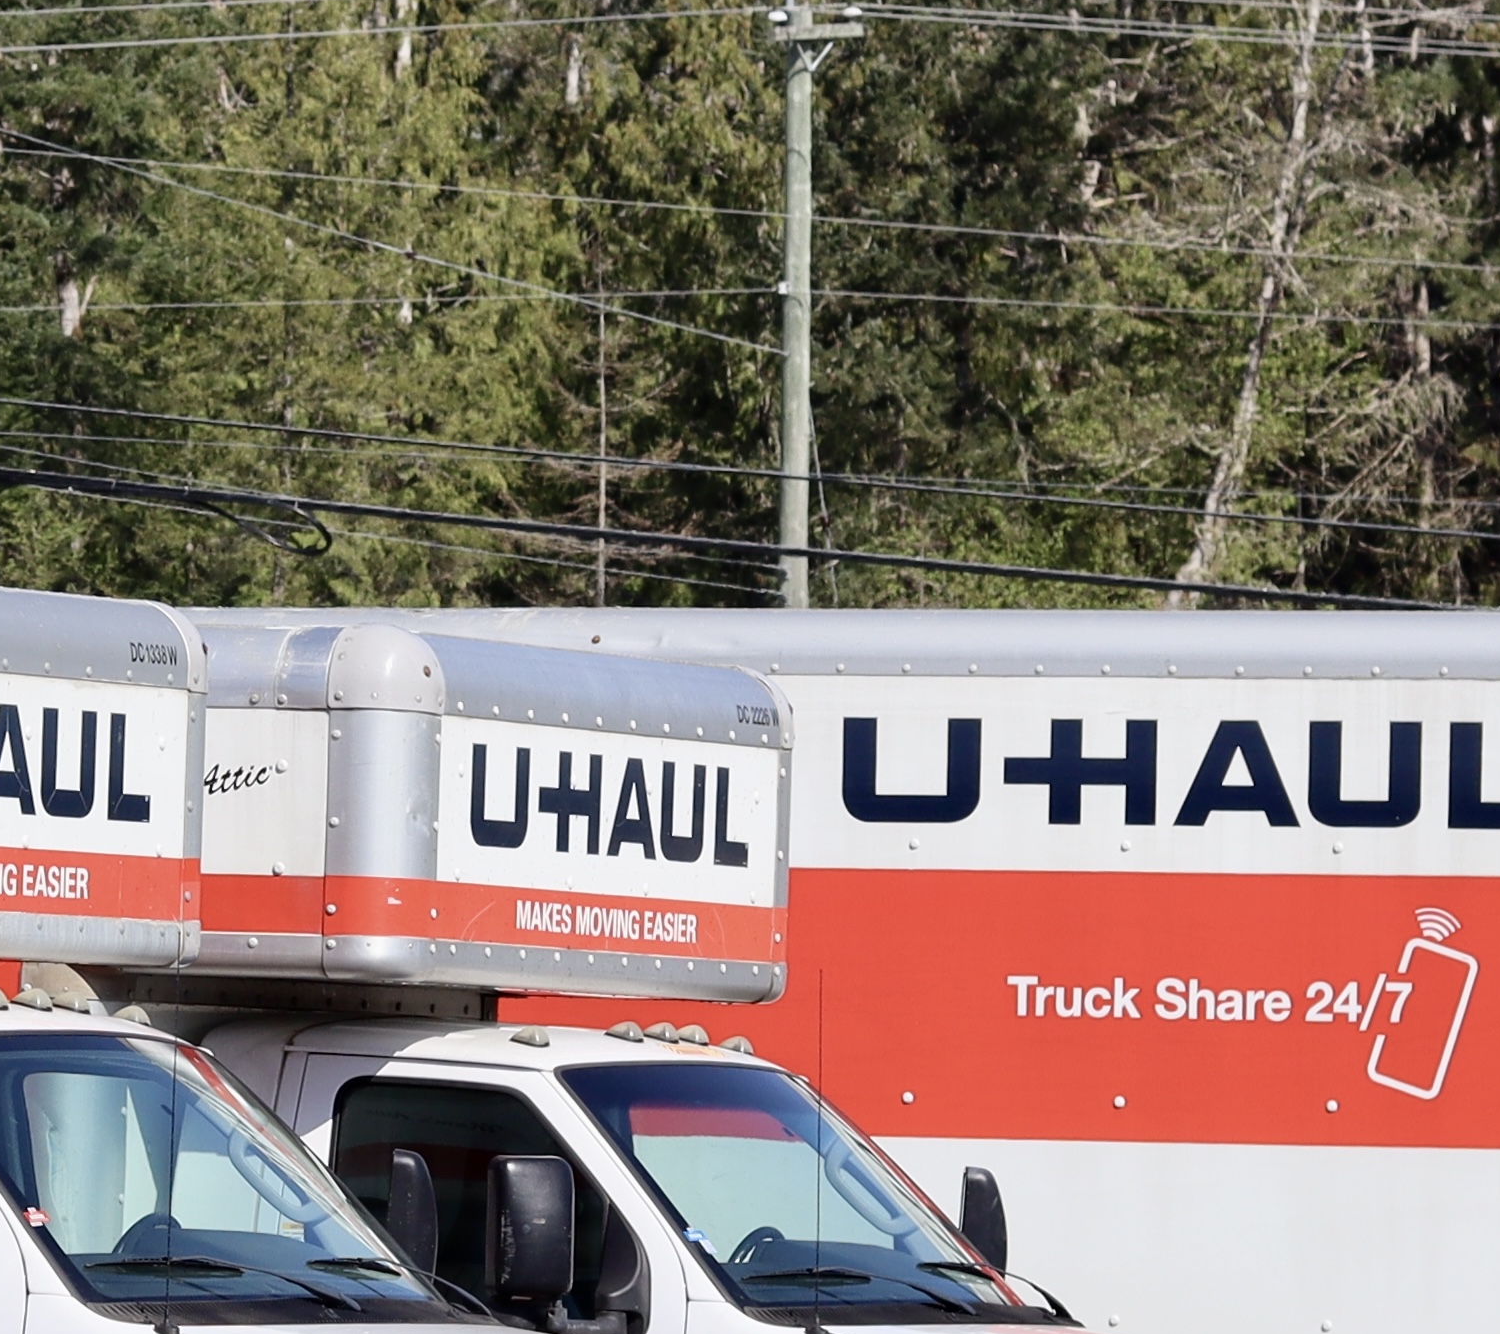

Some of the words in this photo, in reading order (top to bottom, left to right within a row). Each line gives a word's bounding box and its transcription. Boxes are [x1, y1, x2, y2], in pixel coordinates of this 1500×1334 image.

[130, 642, 144, 662] DC
[145, 643, 166, 665] 1338
[167, 646, 177, 666] W
[736, 705, 750, 724] DC
[751, 706, 770, 726] 2226
[470, 743, 749, 868] U-HAUL
[22, 862, 89, 901] EASIER
[516, 900, 572, 935] MAKES
[575, 905, 640, 939] MOVING
[643, 909, 697, 944] EASIER
[1006, 975, 1140, 1020] Truck
[1154, 976, 1292, 1023] Share
[1305, 973, 1413, 1031] 24/7
